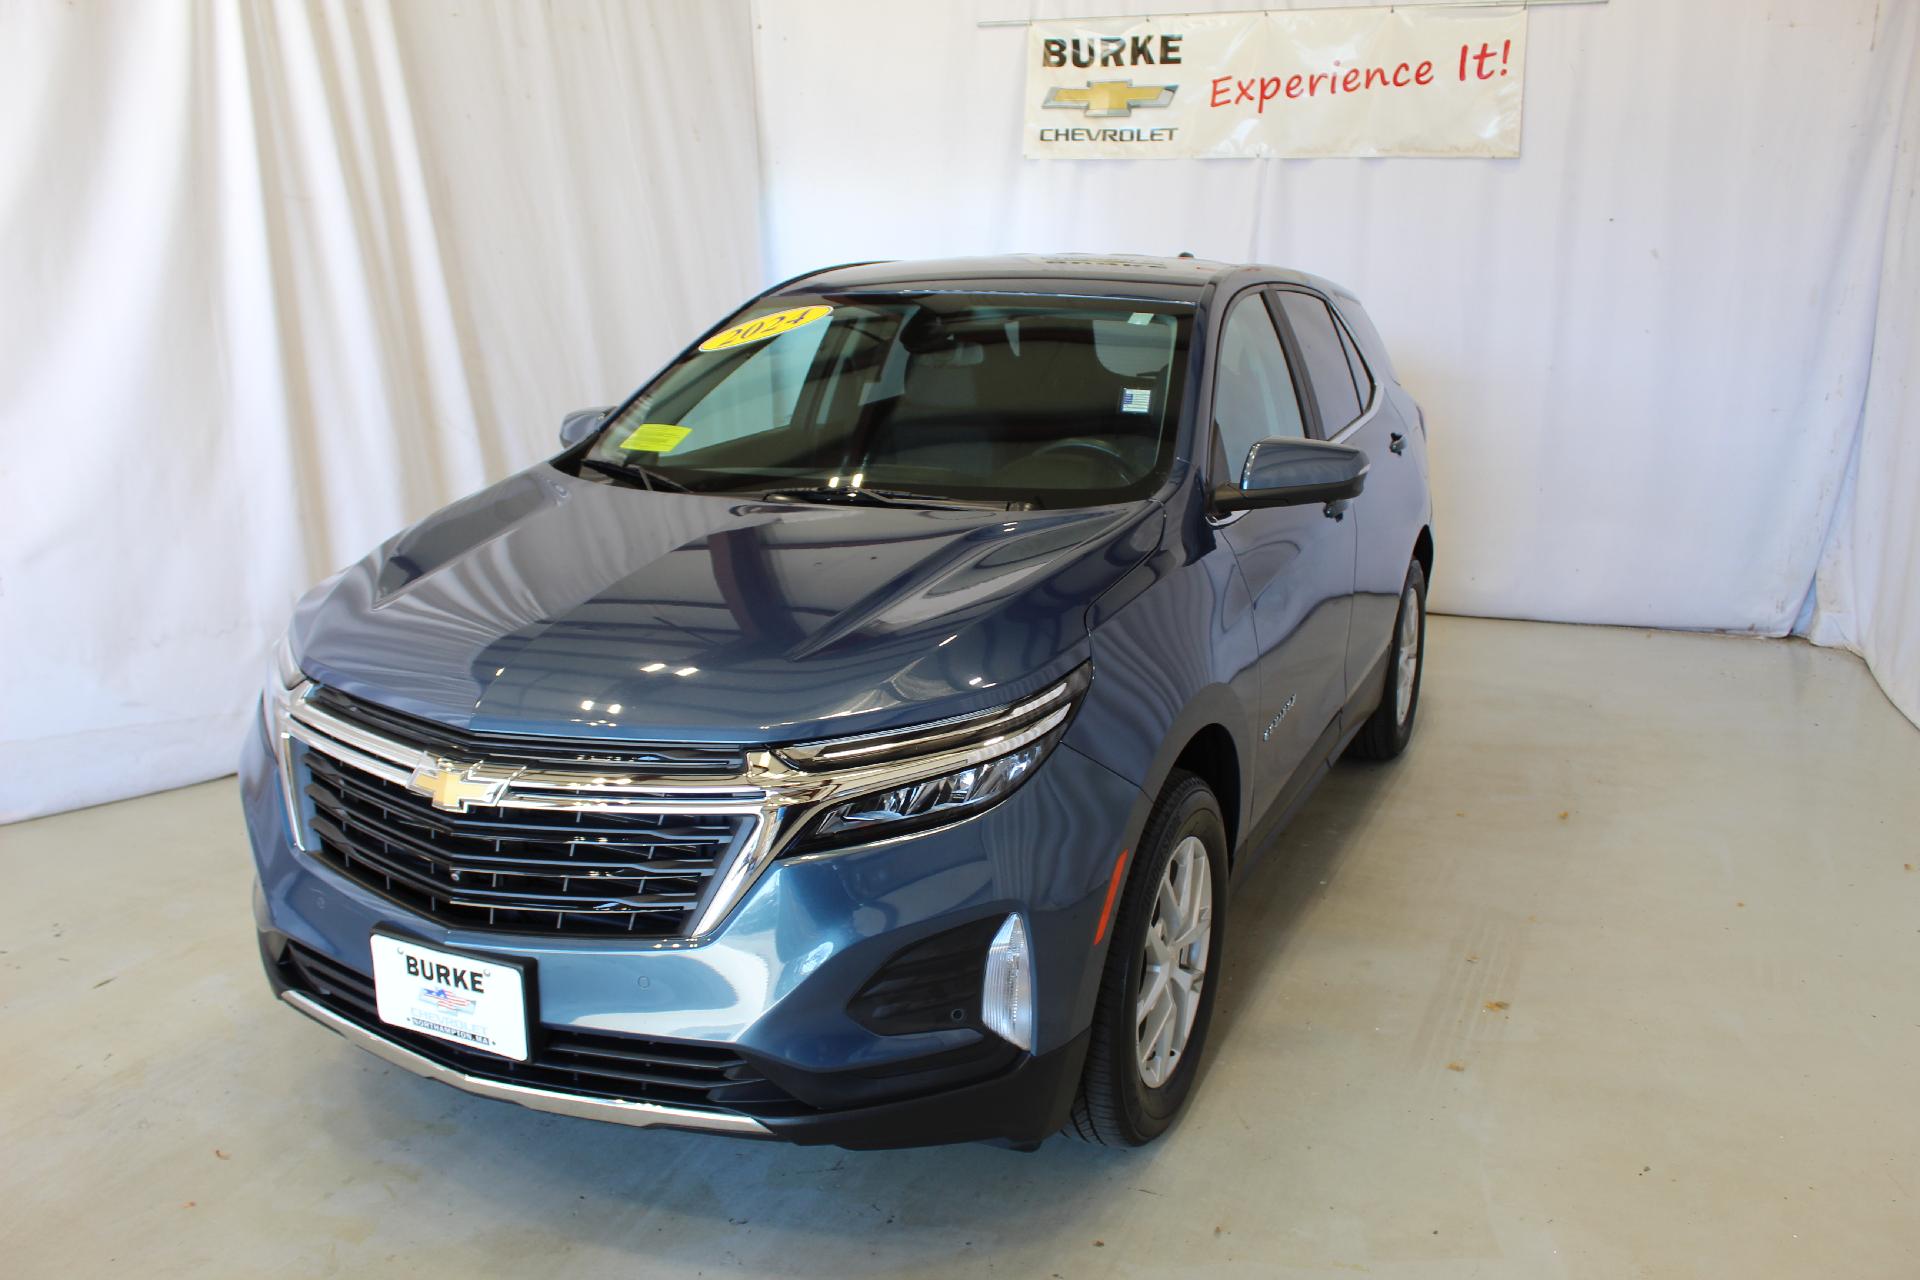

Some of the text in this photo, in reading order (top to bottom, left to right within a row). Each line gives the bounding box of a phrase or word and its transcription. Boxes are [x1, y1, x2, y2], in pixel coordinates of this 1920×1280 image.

[1042, 33, 1184, 68] BURKE
[1208, 39, 1513, 114] Experience It!
[1039, 127, 1179, 142] CHEVROLET
[718, 309, 811, 348] 2024
[405, 955, 485, 994] BURKE
